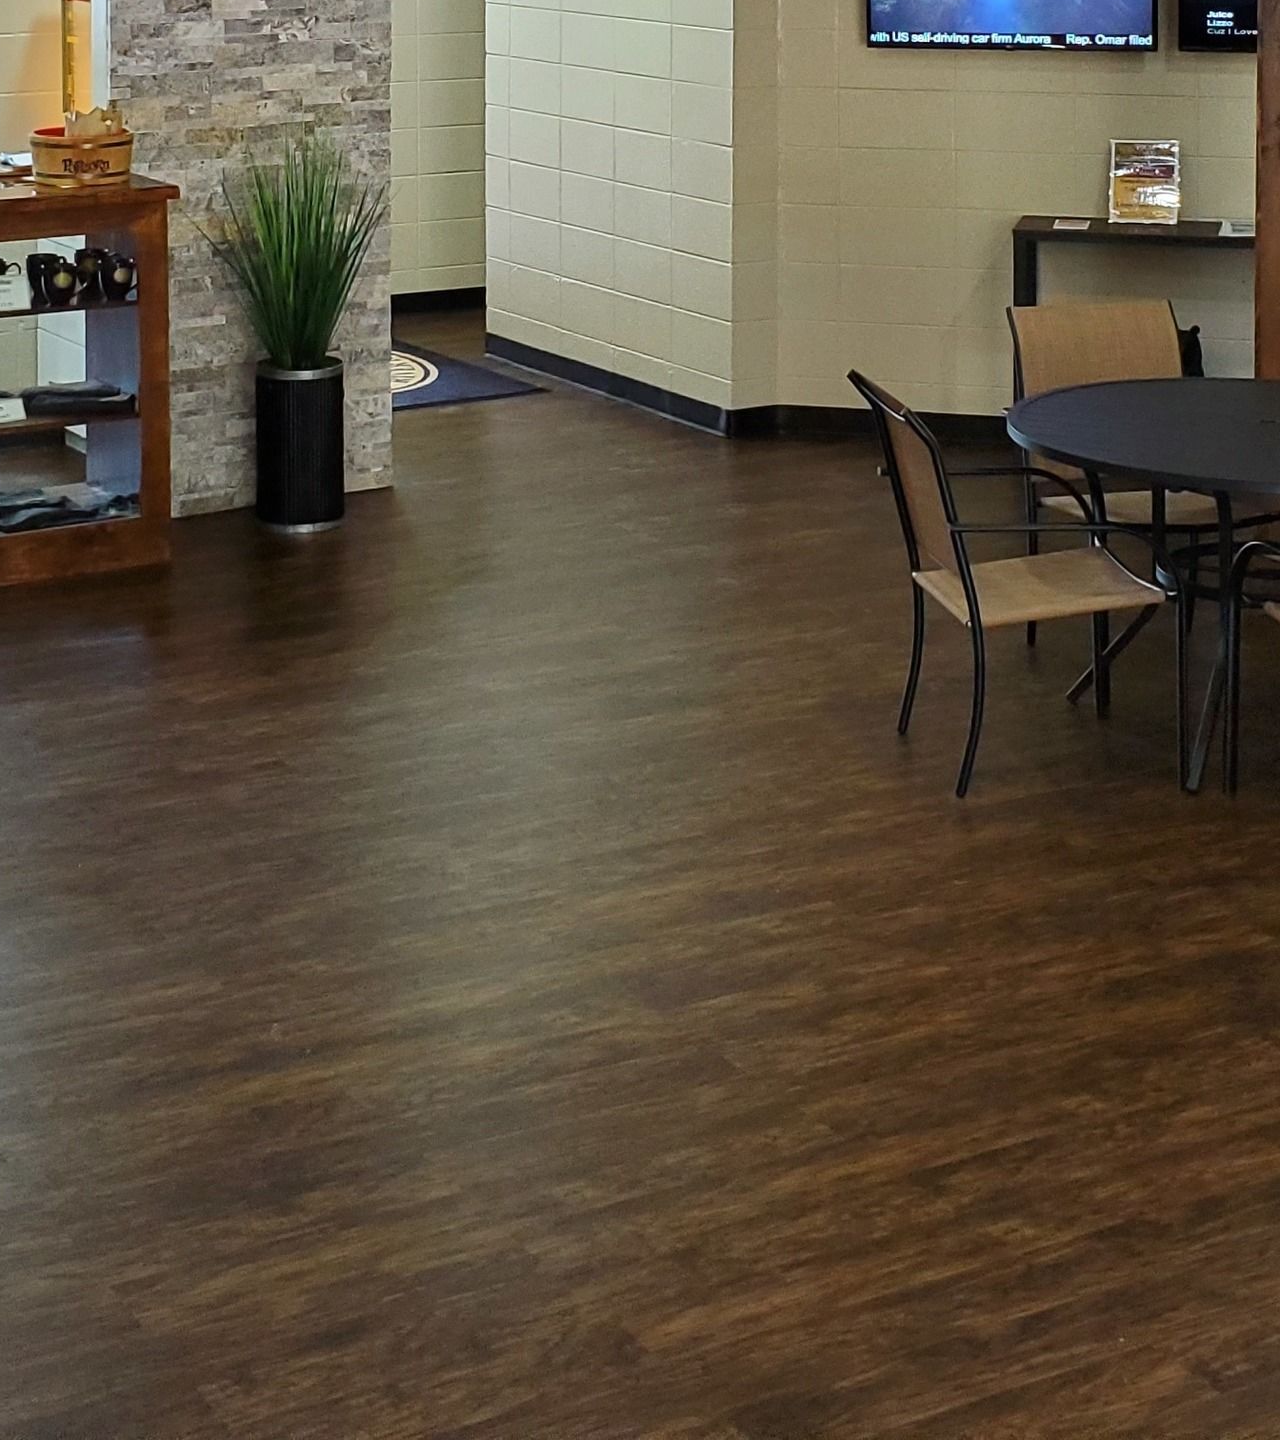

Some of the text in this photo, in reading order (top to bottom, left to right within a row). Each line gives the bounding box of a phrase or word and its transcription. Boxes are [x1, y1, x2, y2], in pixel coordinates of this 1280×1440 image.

[1206, 10, 1234, 18] Juice
[1207, 19, 1234, 27] Lizzo
[892, 32, 909, 42] US
[911, 32, 970, 44] self-driving
[971, 34, 990, 43] car
[991, 33, 1013, 44] firm
[1014, 33, 1051, 44] Aurora
[1065, 34, 1093, 46] Rep.
[1095, 34, 1127, 45] Omar
[1129, 34, 1152, 45] filed
